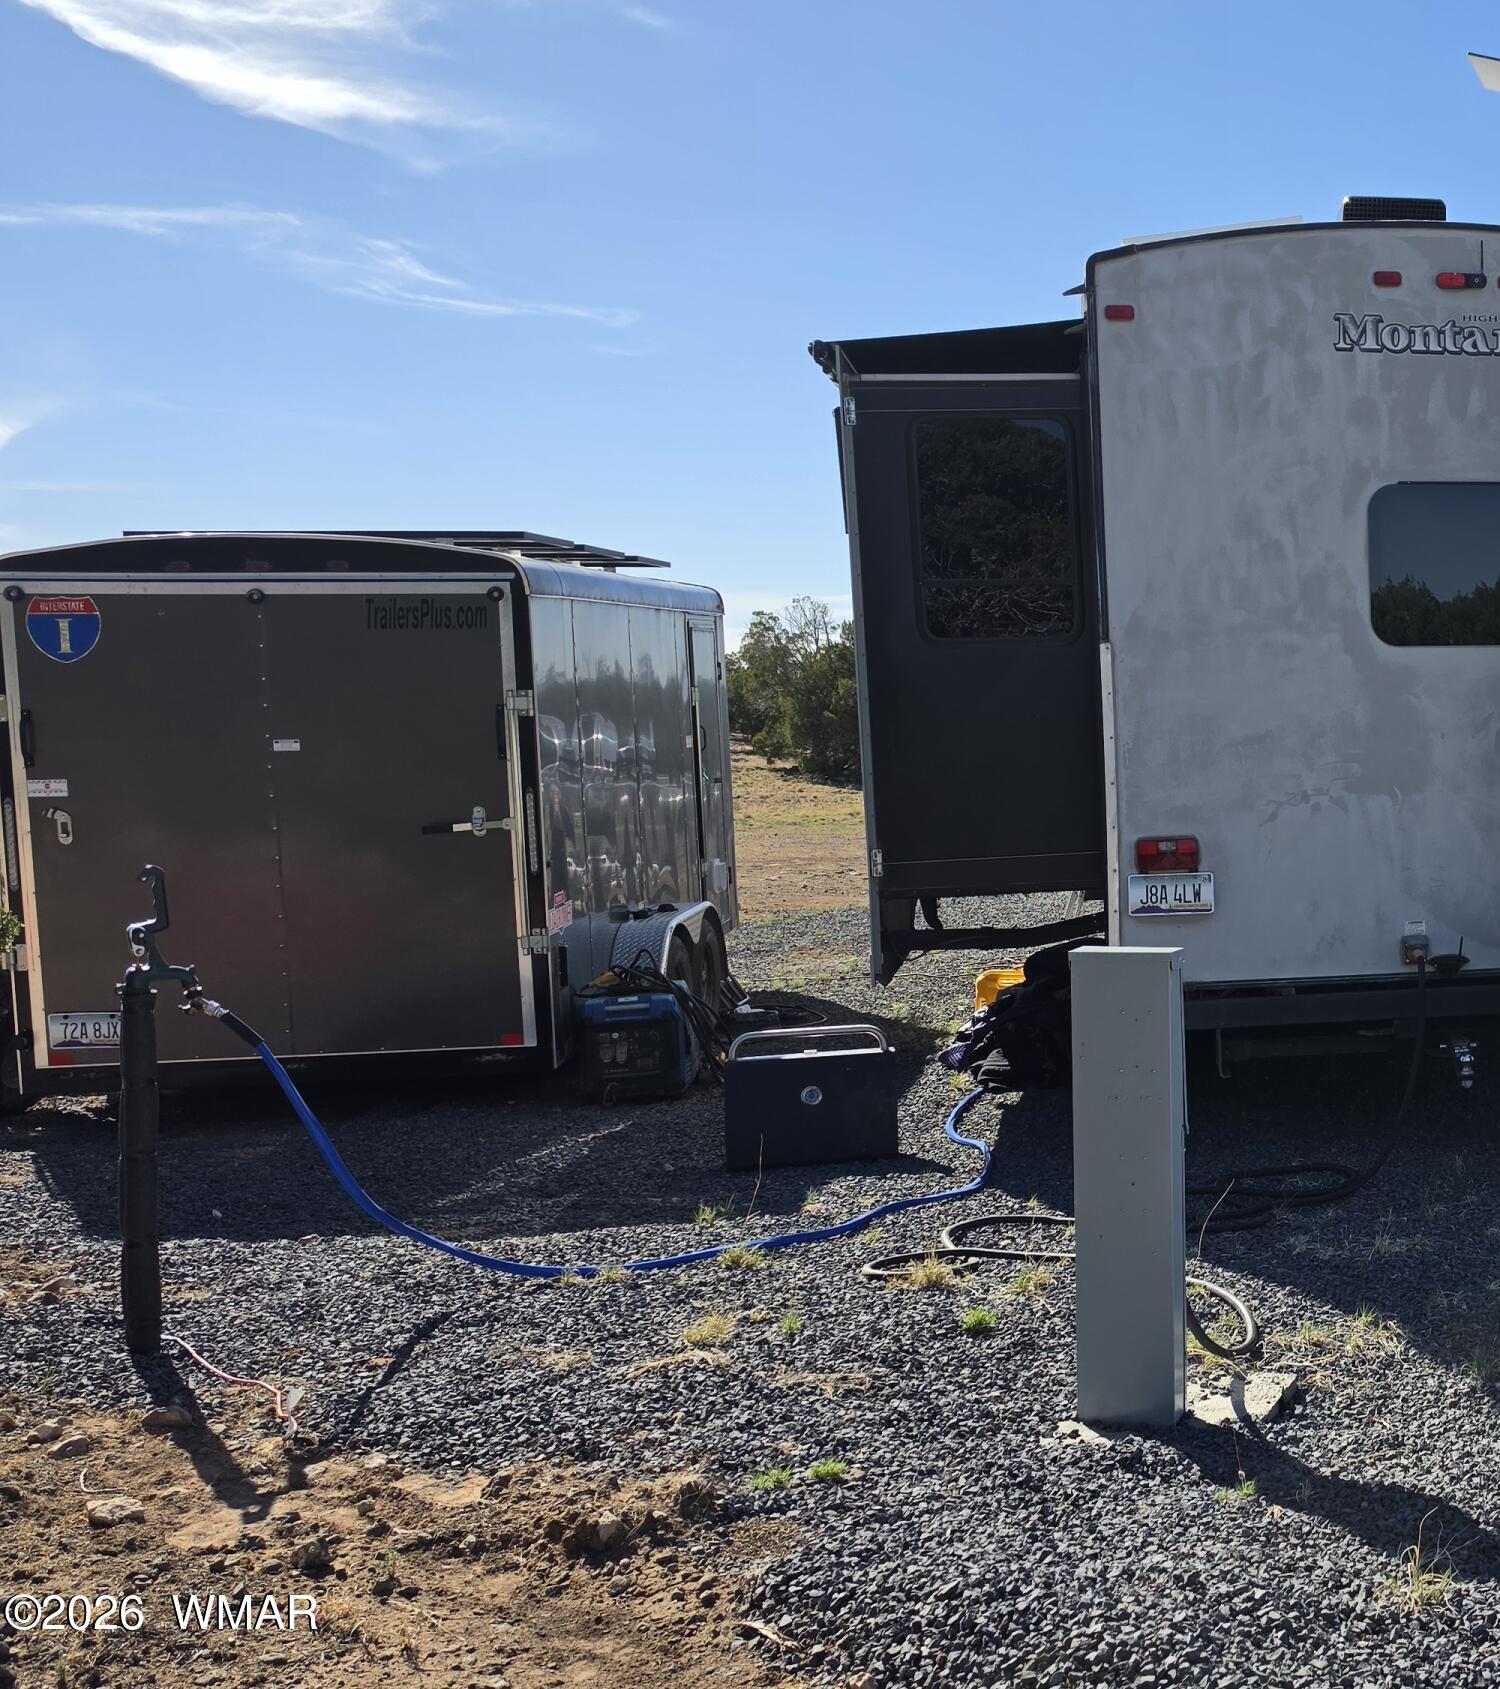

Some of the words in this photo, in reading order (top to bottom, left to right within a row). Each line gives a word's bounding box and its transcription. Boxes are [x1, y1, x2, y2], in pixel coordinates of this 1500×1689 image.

[1462, 314, 1498, 323] HIGH
[39, 600, 86, 611] INTERSTATE
[365, 598, 488, 630] TrailersPlus.com
[1139, 883, 1169, 905] J8A
[1173, 882, 1202, 904] 4LW
[59, 1021, 89, 1040] 72A
[92, 1020, 120, 1039] 8JX
